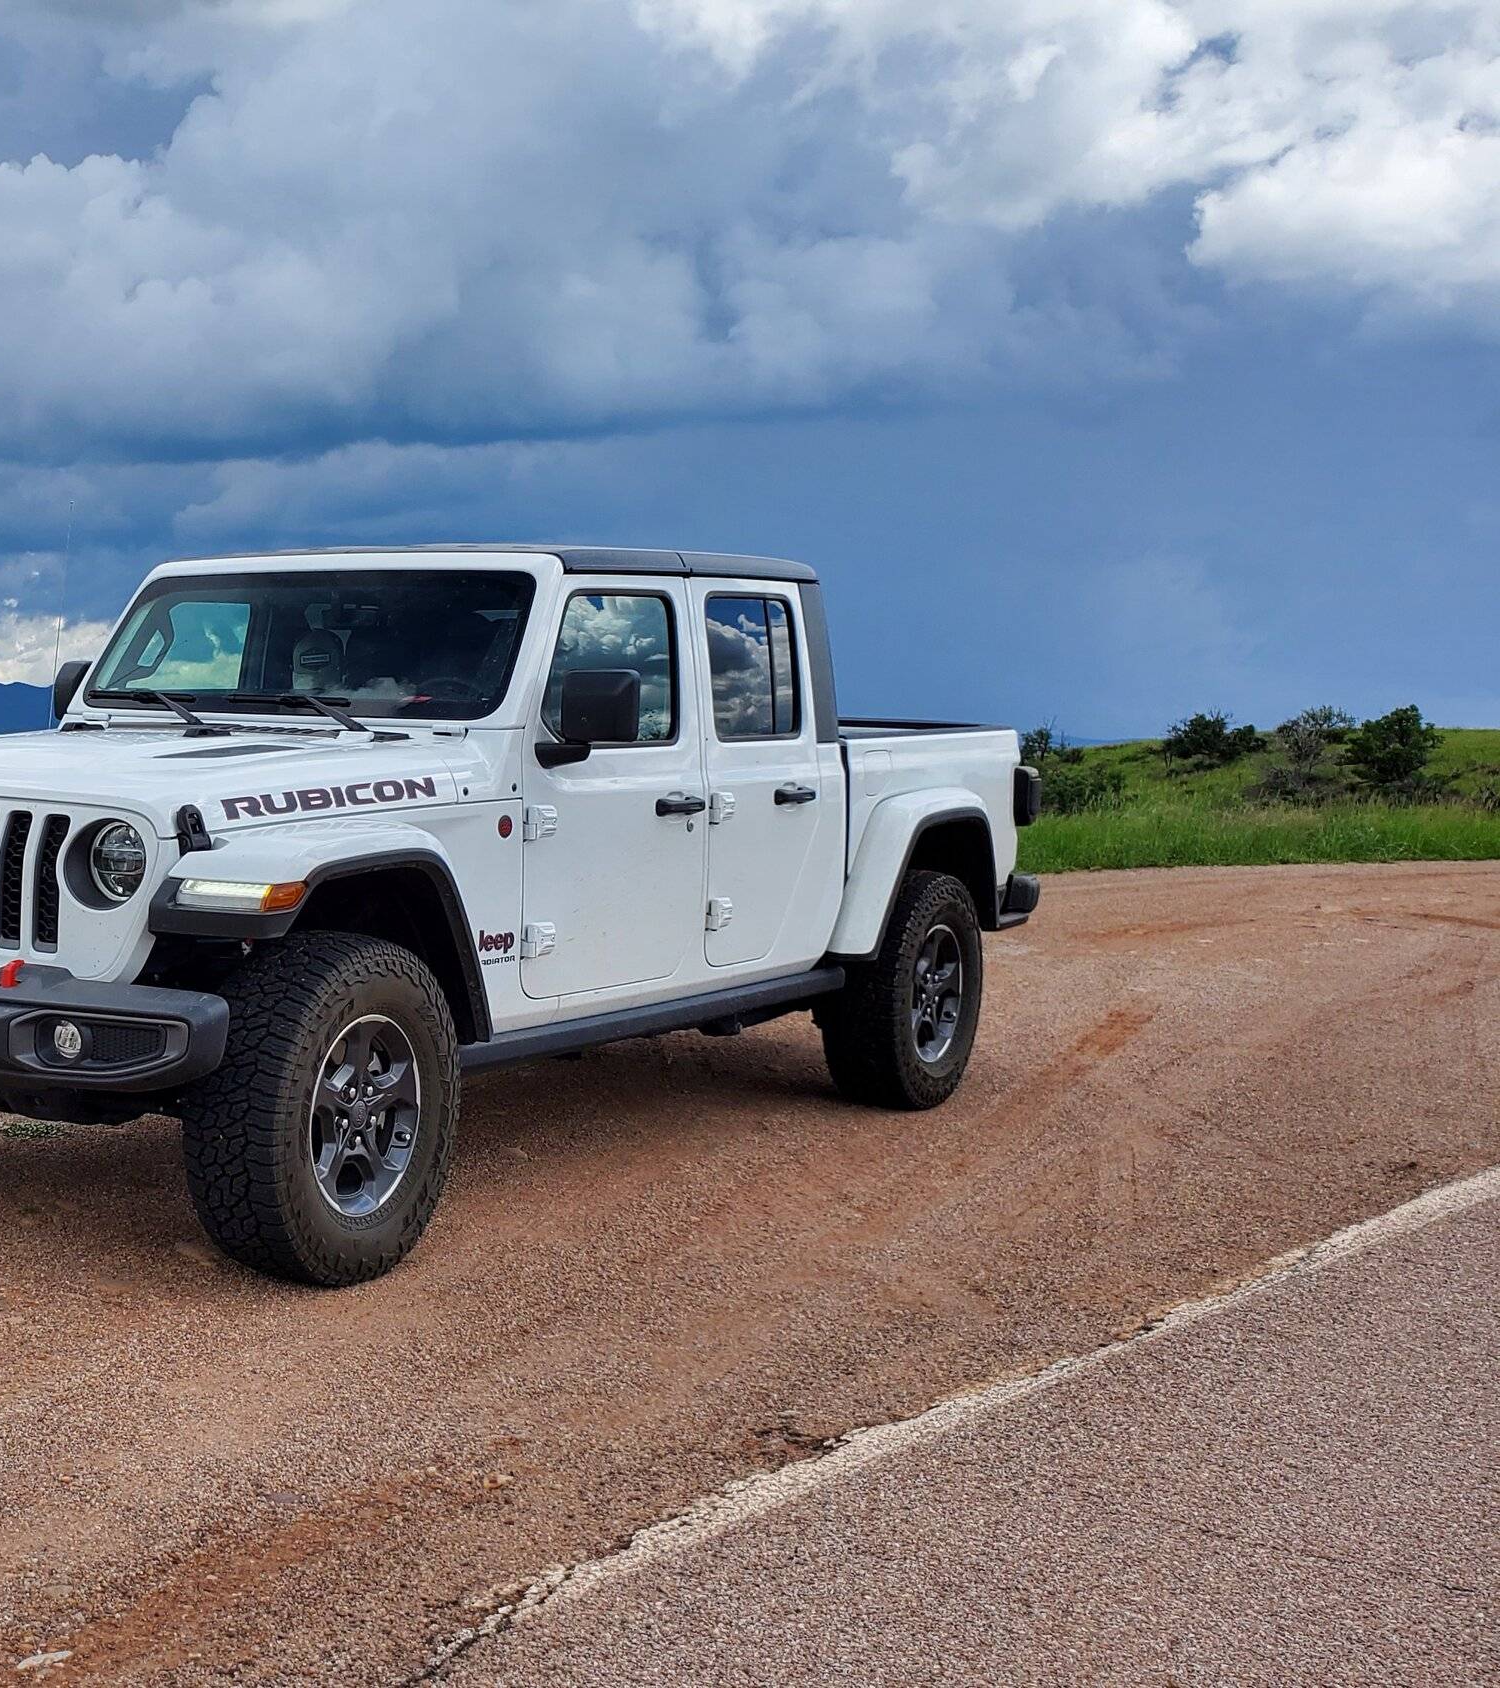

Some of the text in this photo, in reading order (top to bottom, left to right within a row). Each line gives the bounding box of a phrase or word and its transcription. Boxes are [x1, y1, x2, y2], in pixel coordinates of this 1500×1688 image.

[220, 777, 437, 821] RUBICON
[479, 930, 514, 954] Jeep
[481, 955, 515, 966] ADIATOR
